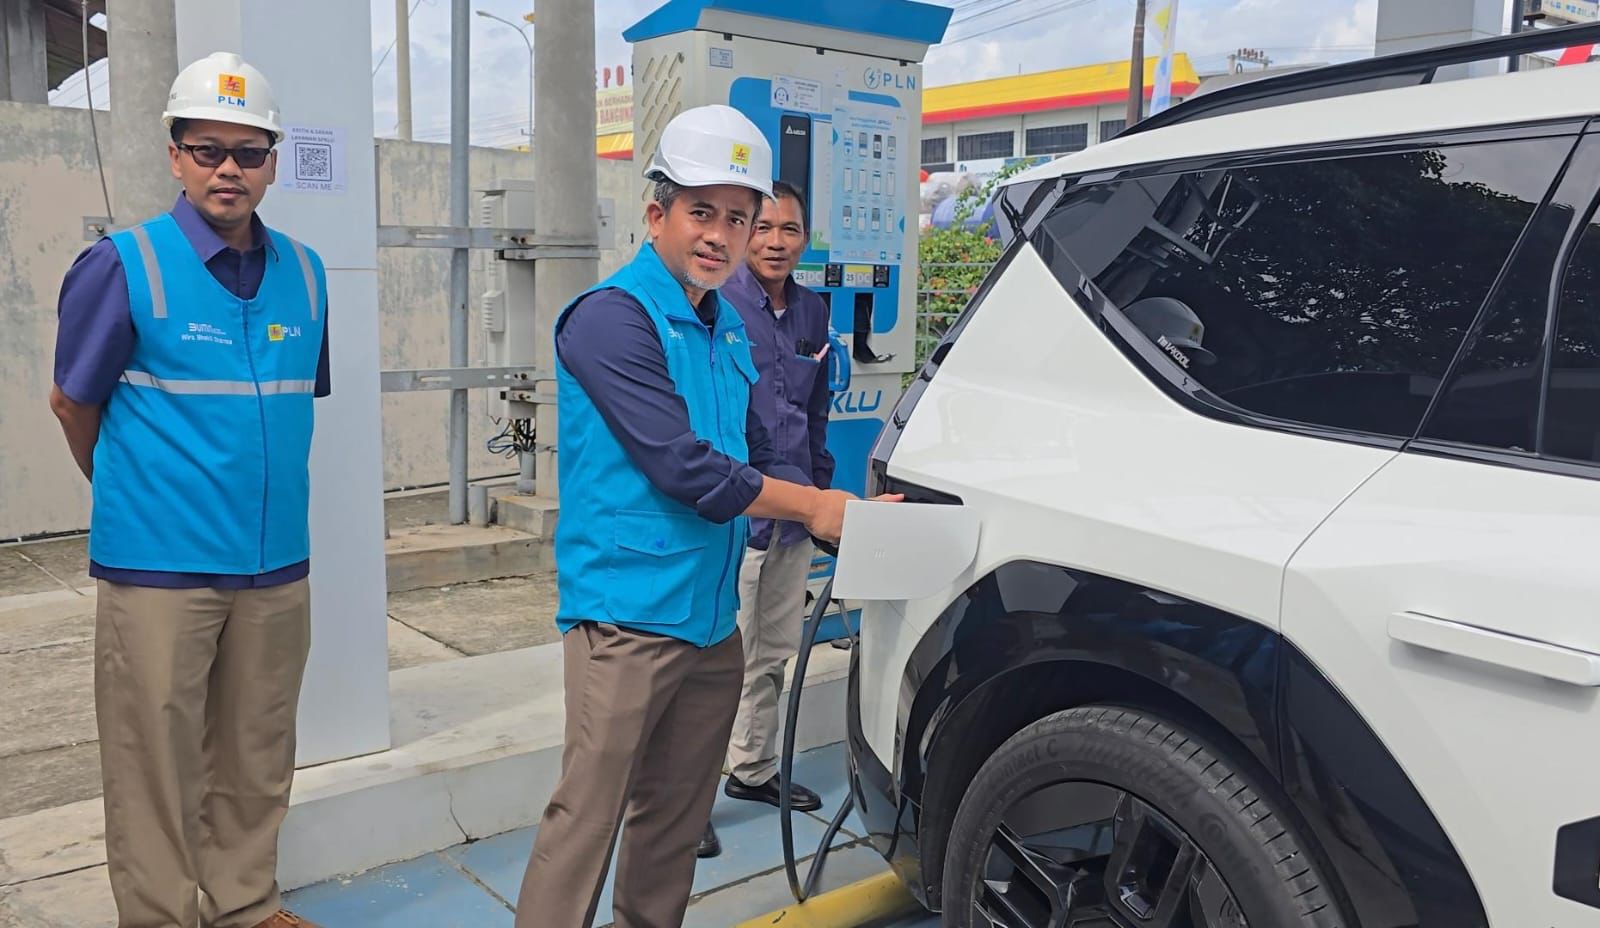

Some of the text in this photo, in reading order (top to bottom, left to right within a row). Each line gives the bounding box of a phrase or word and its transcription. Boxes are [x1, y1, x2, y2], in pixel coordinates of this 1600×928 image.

[883, 72, 916, 90] PLN
[218, 95, 246, 107] PLN
[730, 164, 748, 174] PLN
[296, 181, 319, 190] SCAN
[795, 272, 805, 281] 25
[846, 272, 855, 282] 25
[283, 326, 301, 337] PLN
[827, 390, 882, 414] KLU
